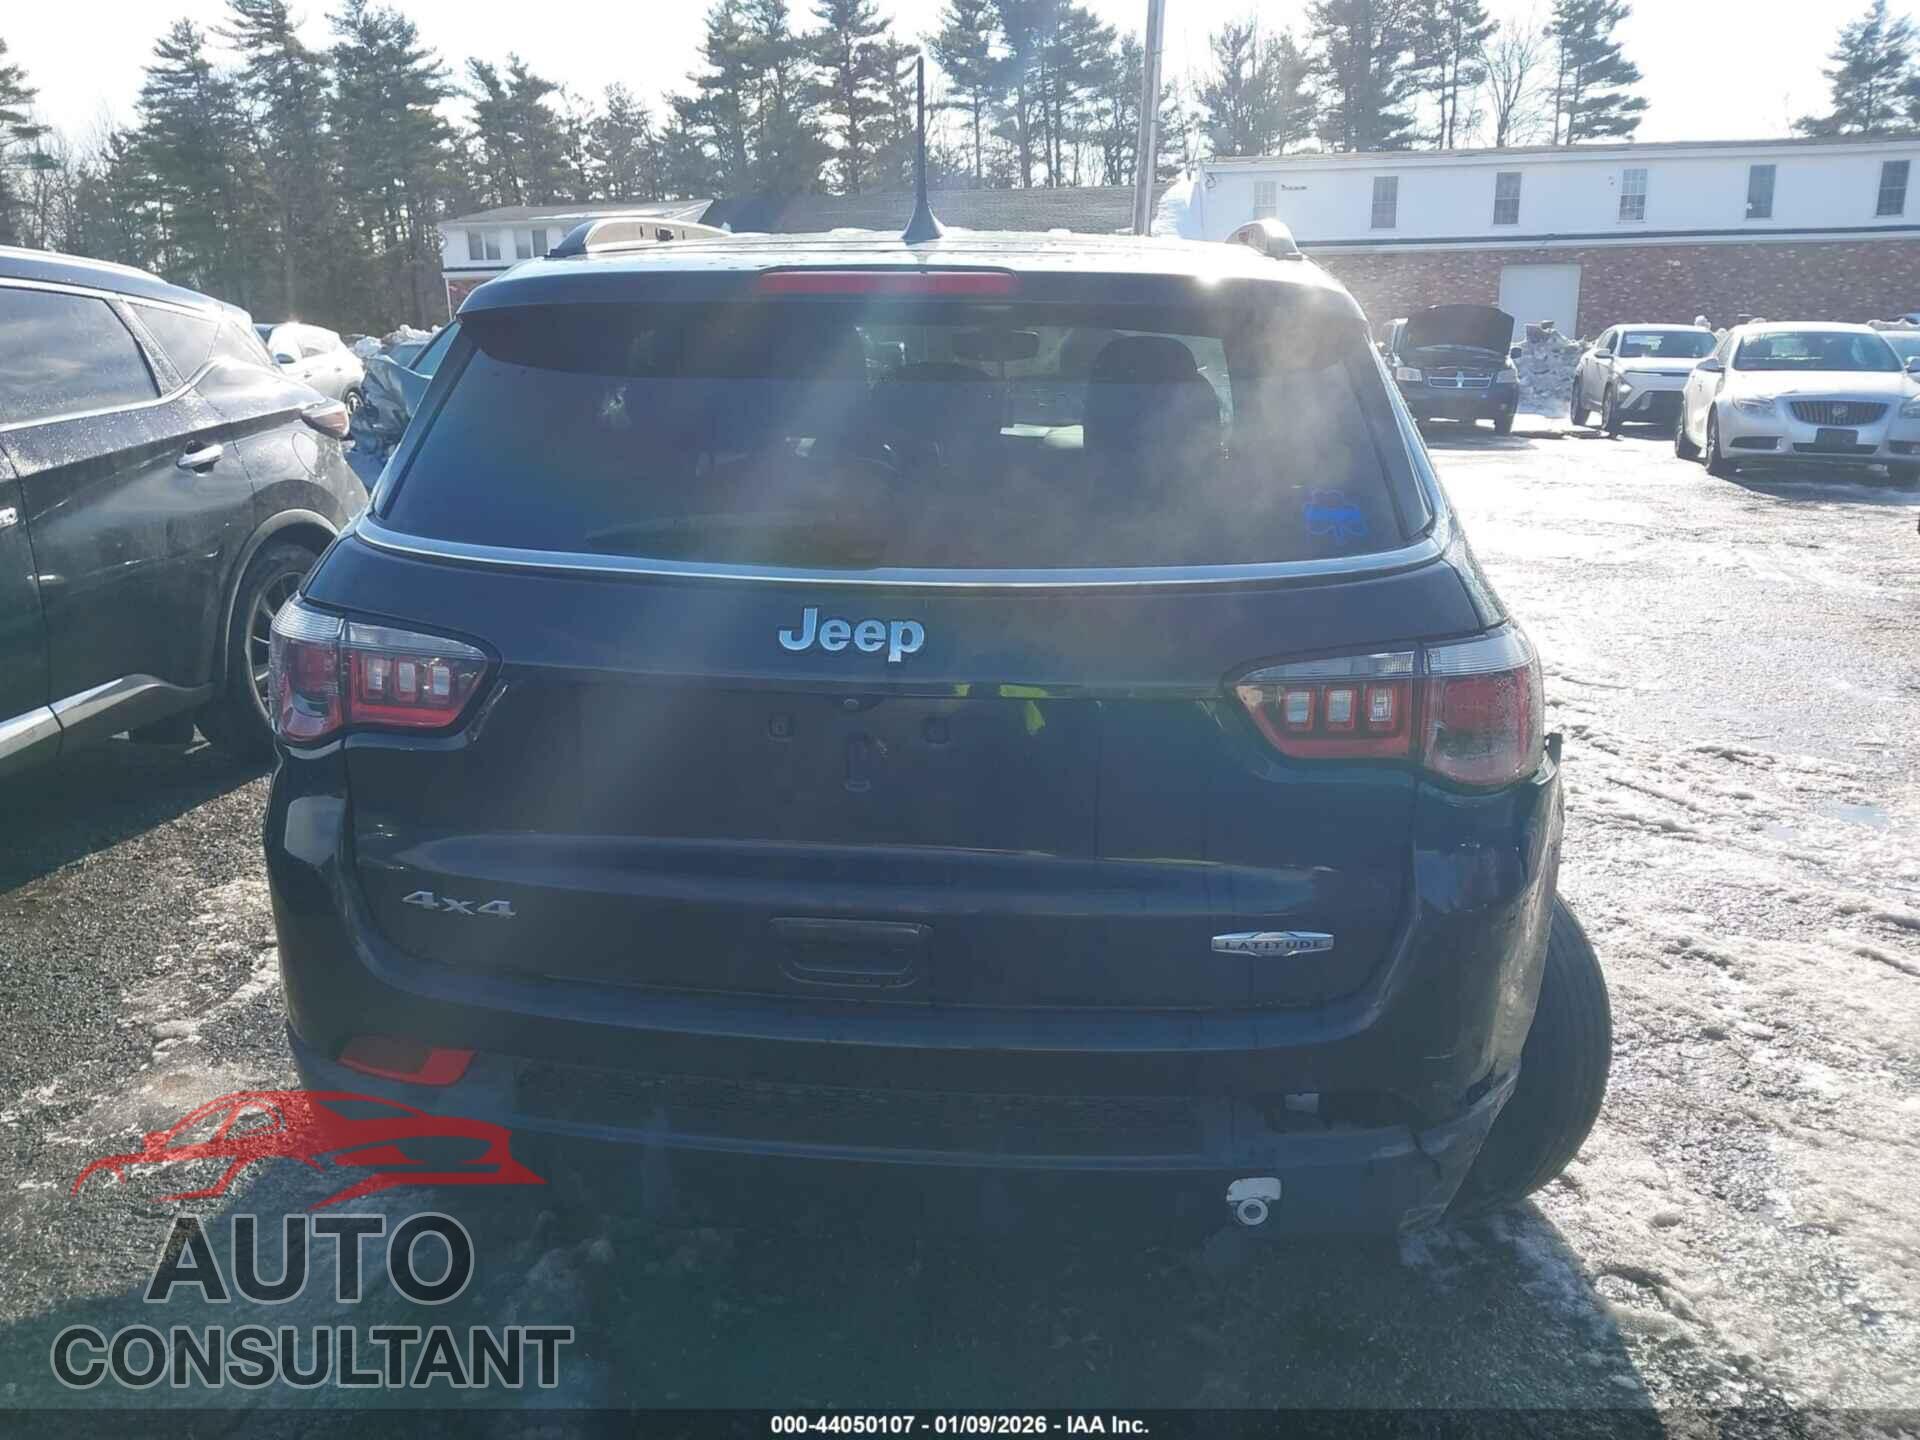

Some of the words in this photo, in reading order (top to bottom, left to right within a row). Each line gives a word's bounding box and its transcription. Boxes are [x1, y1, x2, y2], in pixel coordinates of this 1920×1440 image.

[779, 607, 925, 662] Jeep
[402, 890, 517, 918] 4x4
[1224, 940, 1325, 951] LATITUDE
